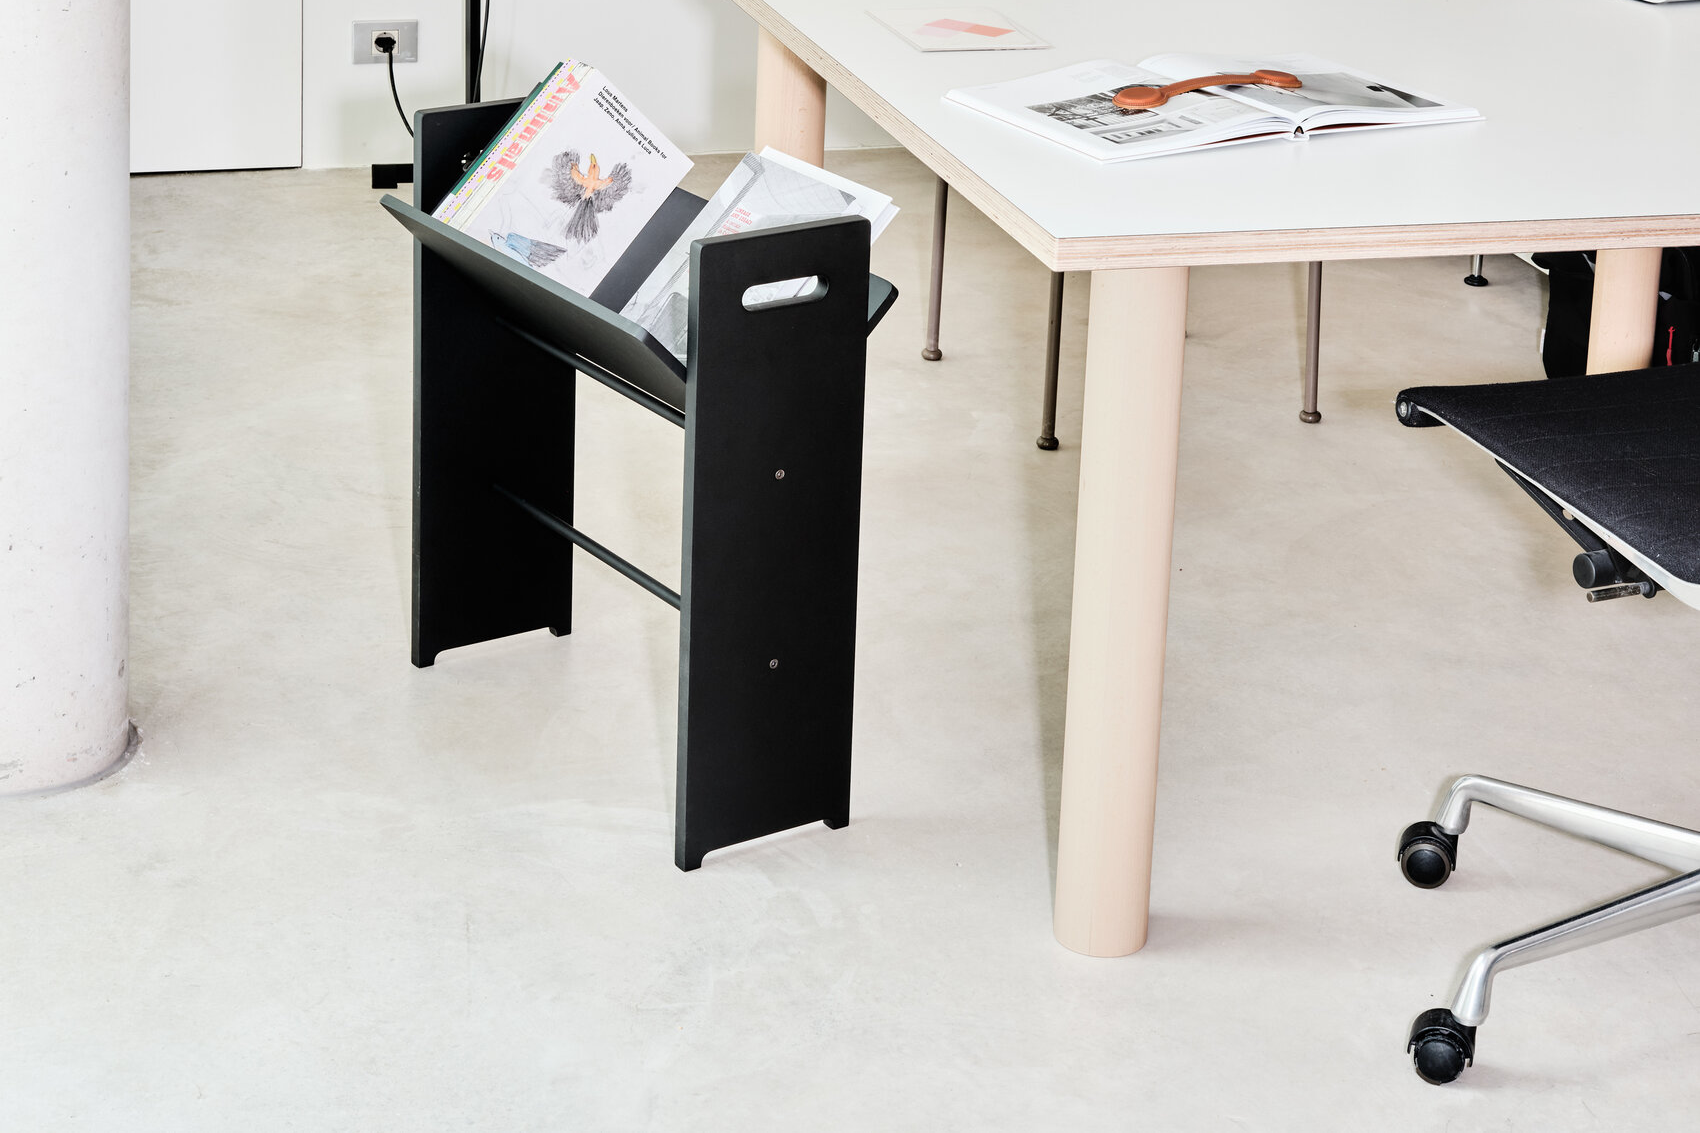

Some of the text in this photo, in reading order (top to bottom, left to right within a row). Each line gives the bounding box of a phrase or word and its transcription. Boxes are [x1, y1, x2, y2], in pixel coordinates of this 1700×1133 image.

[597, 91, 625, 118] Dierenboeken
[634, 126, 648, 141] Animal
[647, 139, 660, 153] Books
[612, 95, 628, 112] Martens
[486, 73, 581, 181] Animals
[626, 128, 638, 141] Julian
[641, 143, 652, 154] Luca
